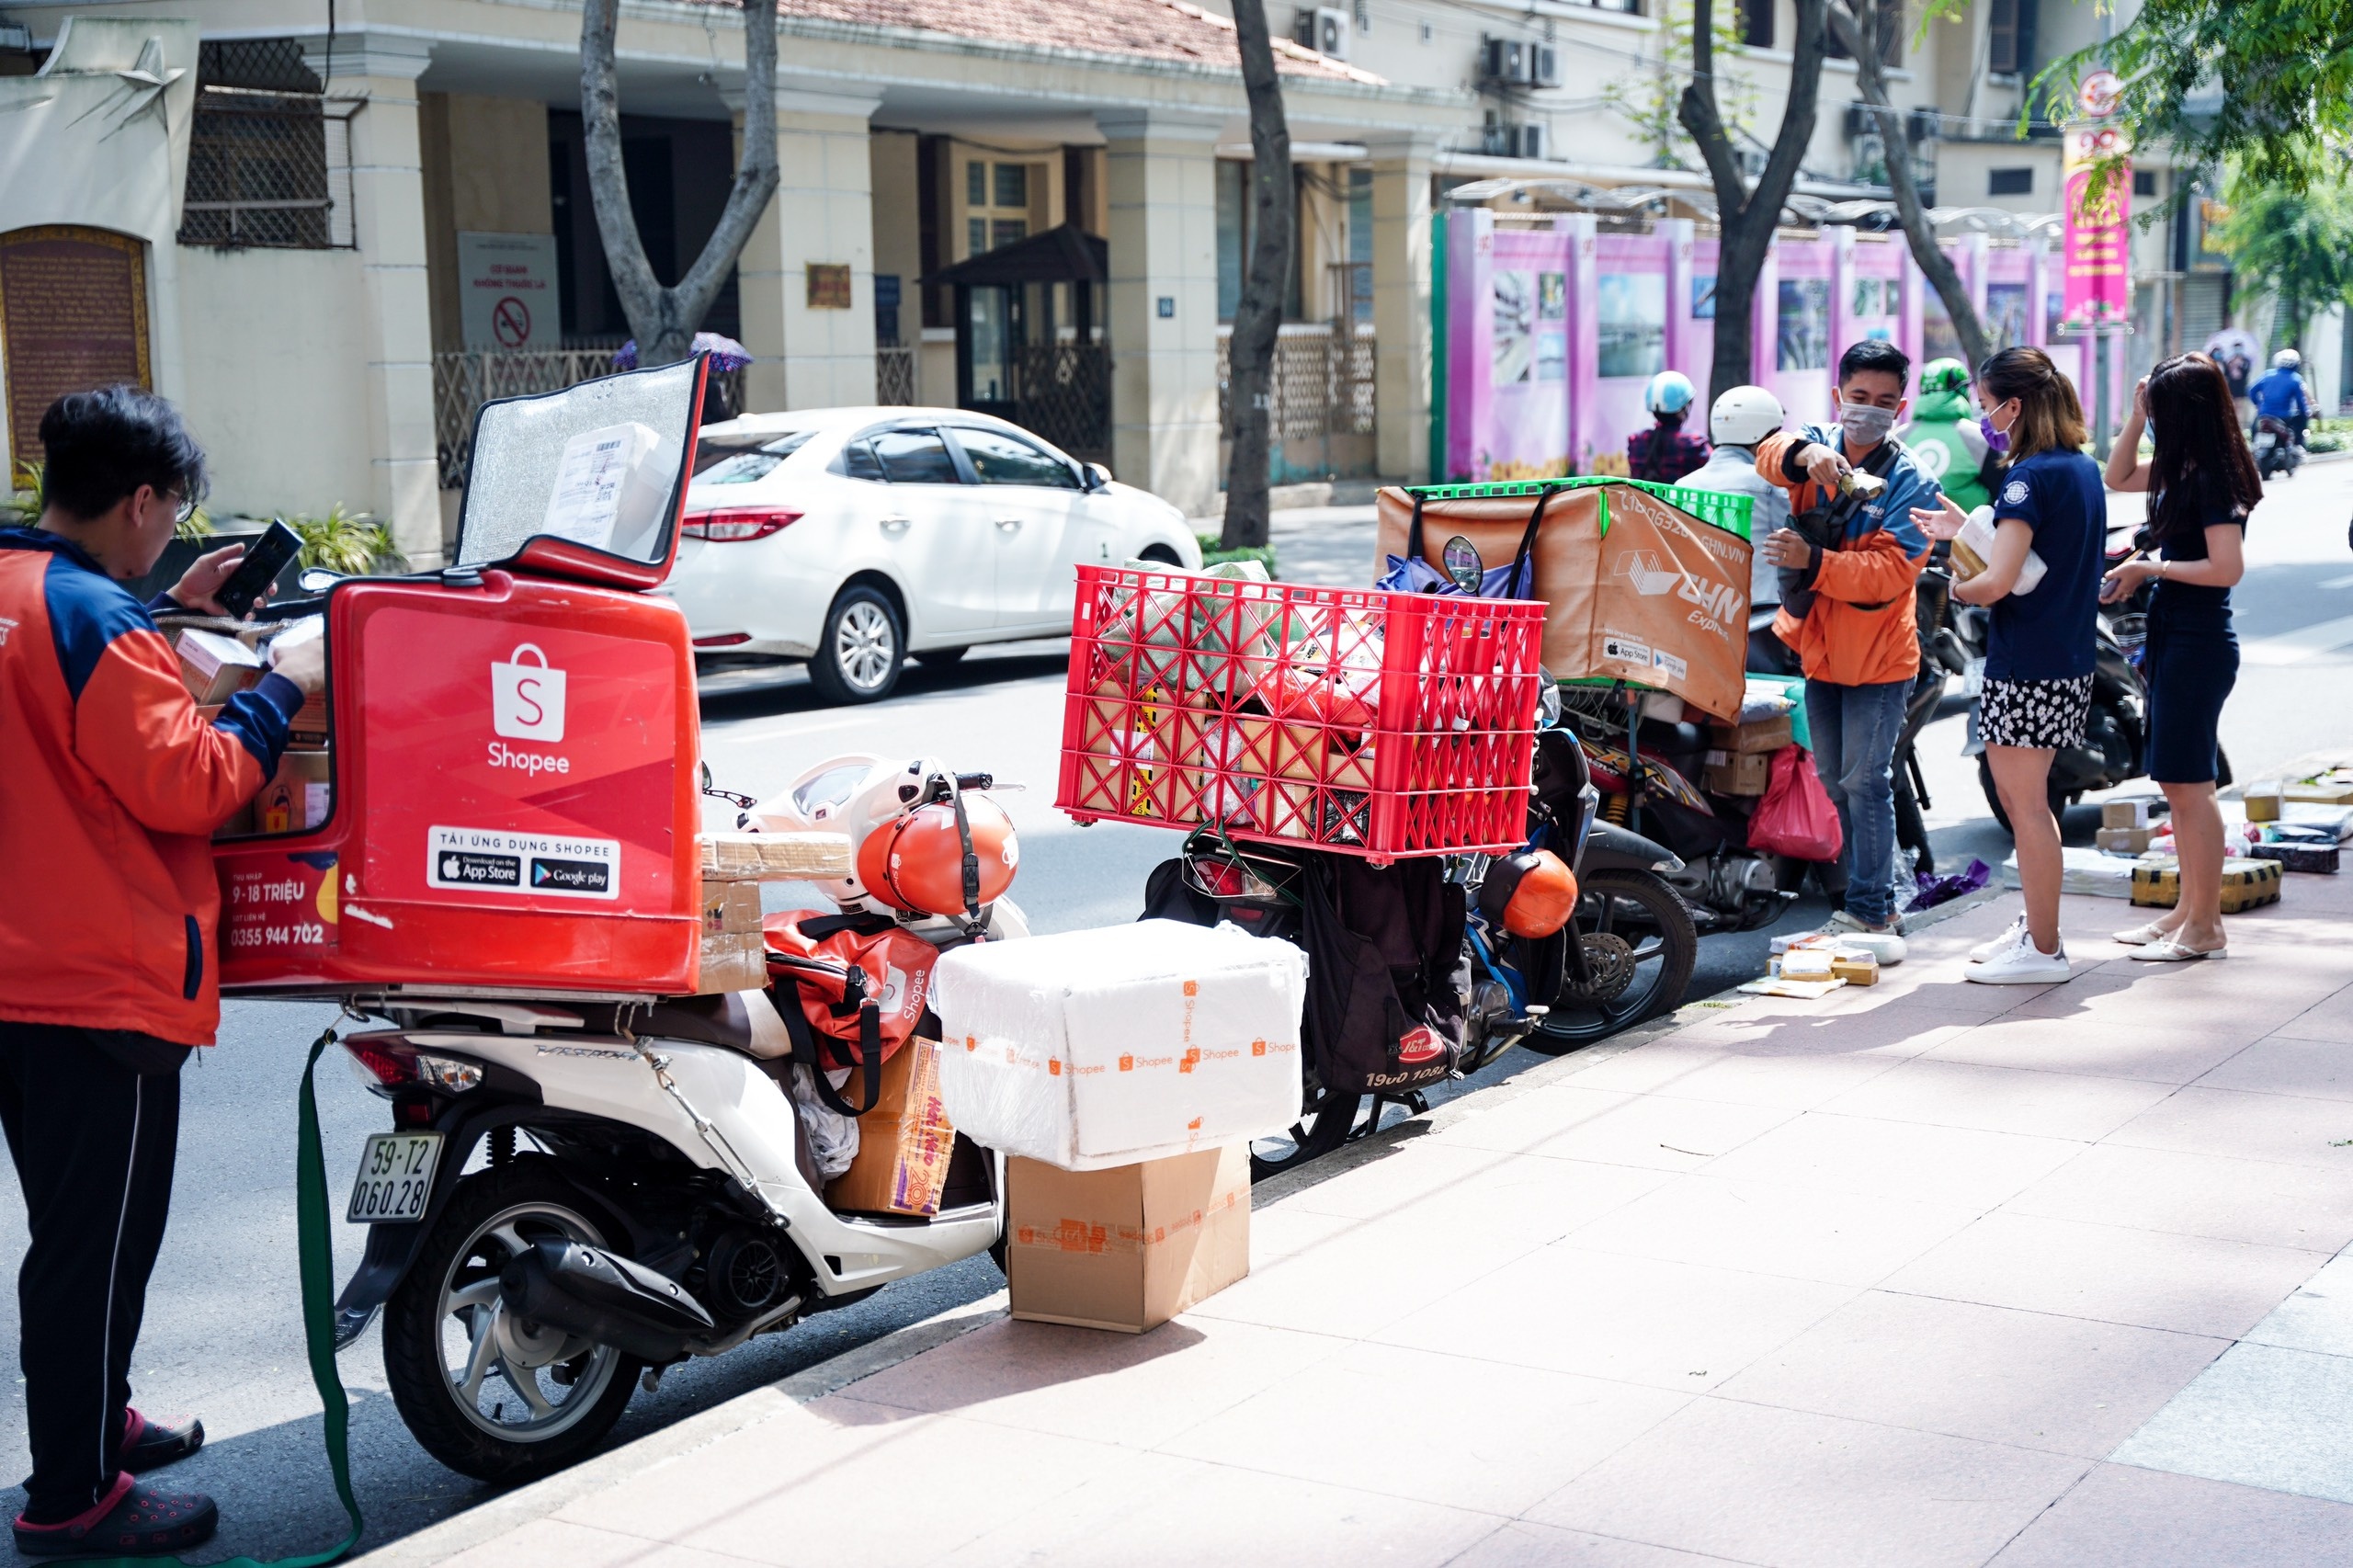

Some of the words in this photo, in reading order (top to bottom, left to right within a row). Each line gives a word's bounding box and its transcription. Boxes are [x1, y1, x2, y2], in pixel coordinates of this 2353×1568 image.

[1700, 535, 1745, 564] GHN.VN
[1620, 648, 1633, 658] App
[1634, 651, 1648, 662] Store
[487, 742, 570, 778] Shopee
[440, 834, 463, 845] TẢI
[509, 839, 548, 851] DỤNG
[555, 843, 609, 857] SHOPEE
[462, 856, 495, 867] Download
[505, 858, 517, 867] the
[462, 865, 486, 880] App
[487, 866, 516, 881] Store
[553, 869, 586, 886] Google
[587, 872, 607, 886] play
[263, 879, 305, 904] TRIỆU
[231, 927, 262, 947] 0355
[266, 926, 289, 945] 944
[292, 924, 324, 944] 702
[903, 969, 926, 1024] Shopee
[1183, 999, 1195, 1043] Shopee
[1136, 1056, 1173, 1069] Shopee
[1202, 1049, 1239, 1061] Shopee
[1064, 1062, 1106, 1077] Shopee
[370, 1139, 430, 1176] 59-T2
[352, 1180, 425, 1217] 060.28
